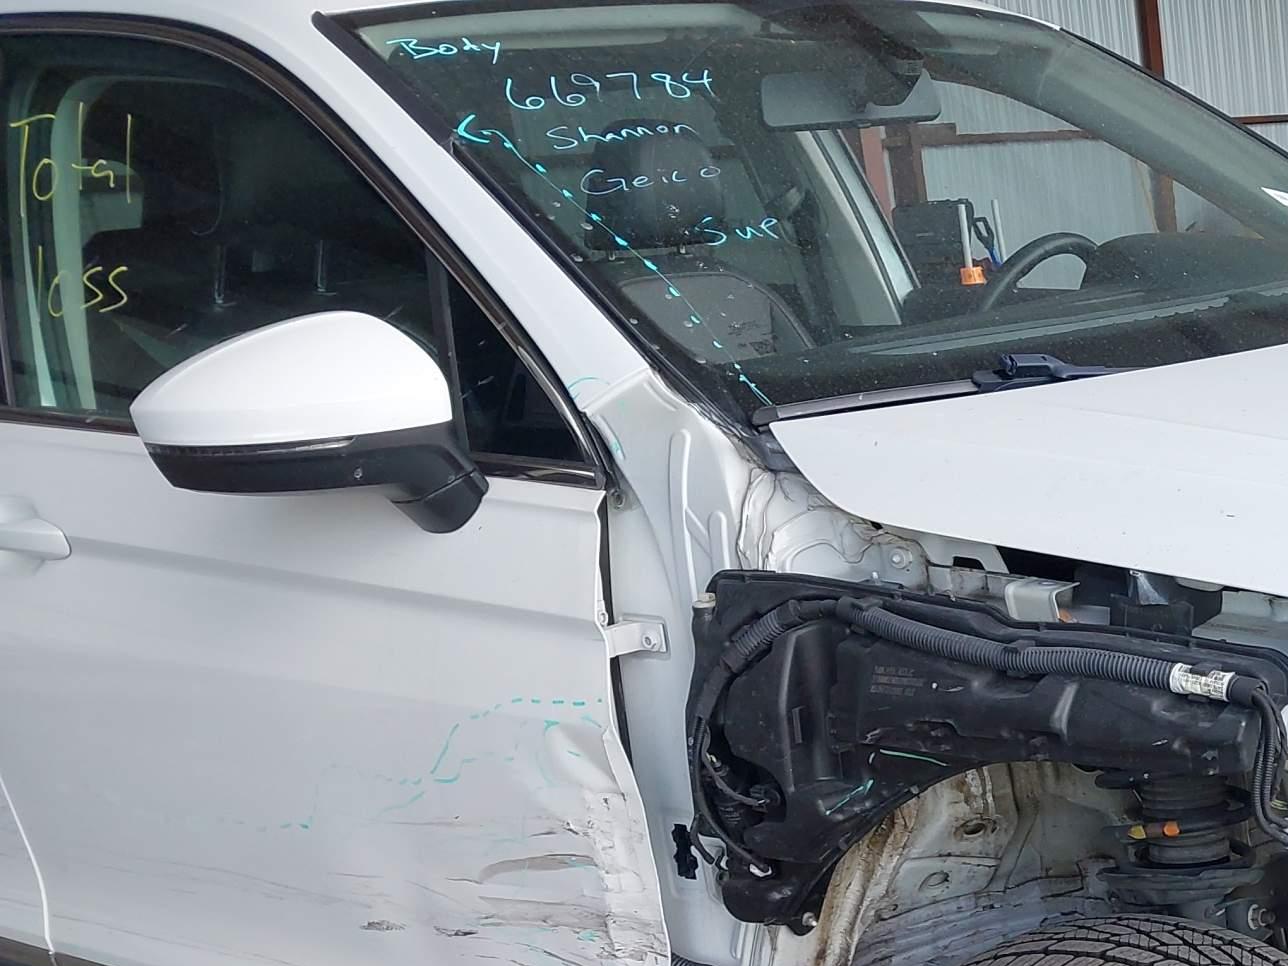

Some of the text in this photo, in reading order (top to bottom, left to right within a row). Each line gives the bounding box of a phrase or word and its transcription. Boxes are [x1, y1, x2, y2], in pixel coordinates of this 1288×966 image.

[505, 69, 720, 110] 669784
[545, 123, 698, 151] Shannon
[9, 101, 132, 217] Total
